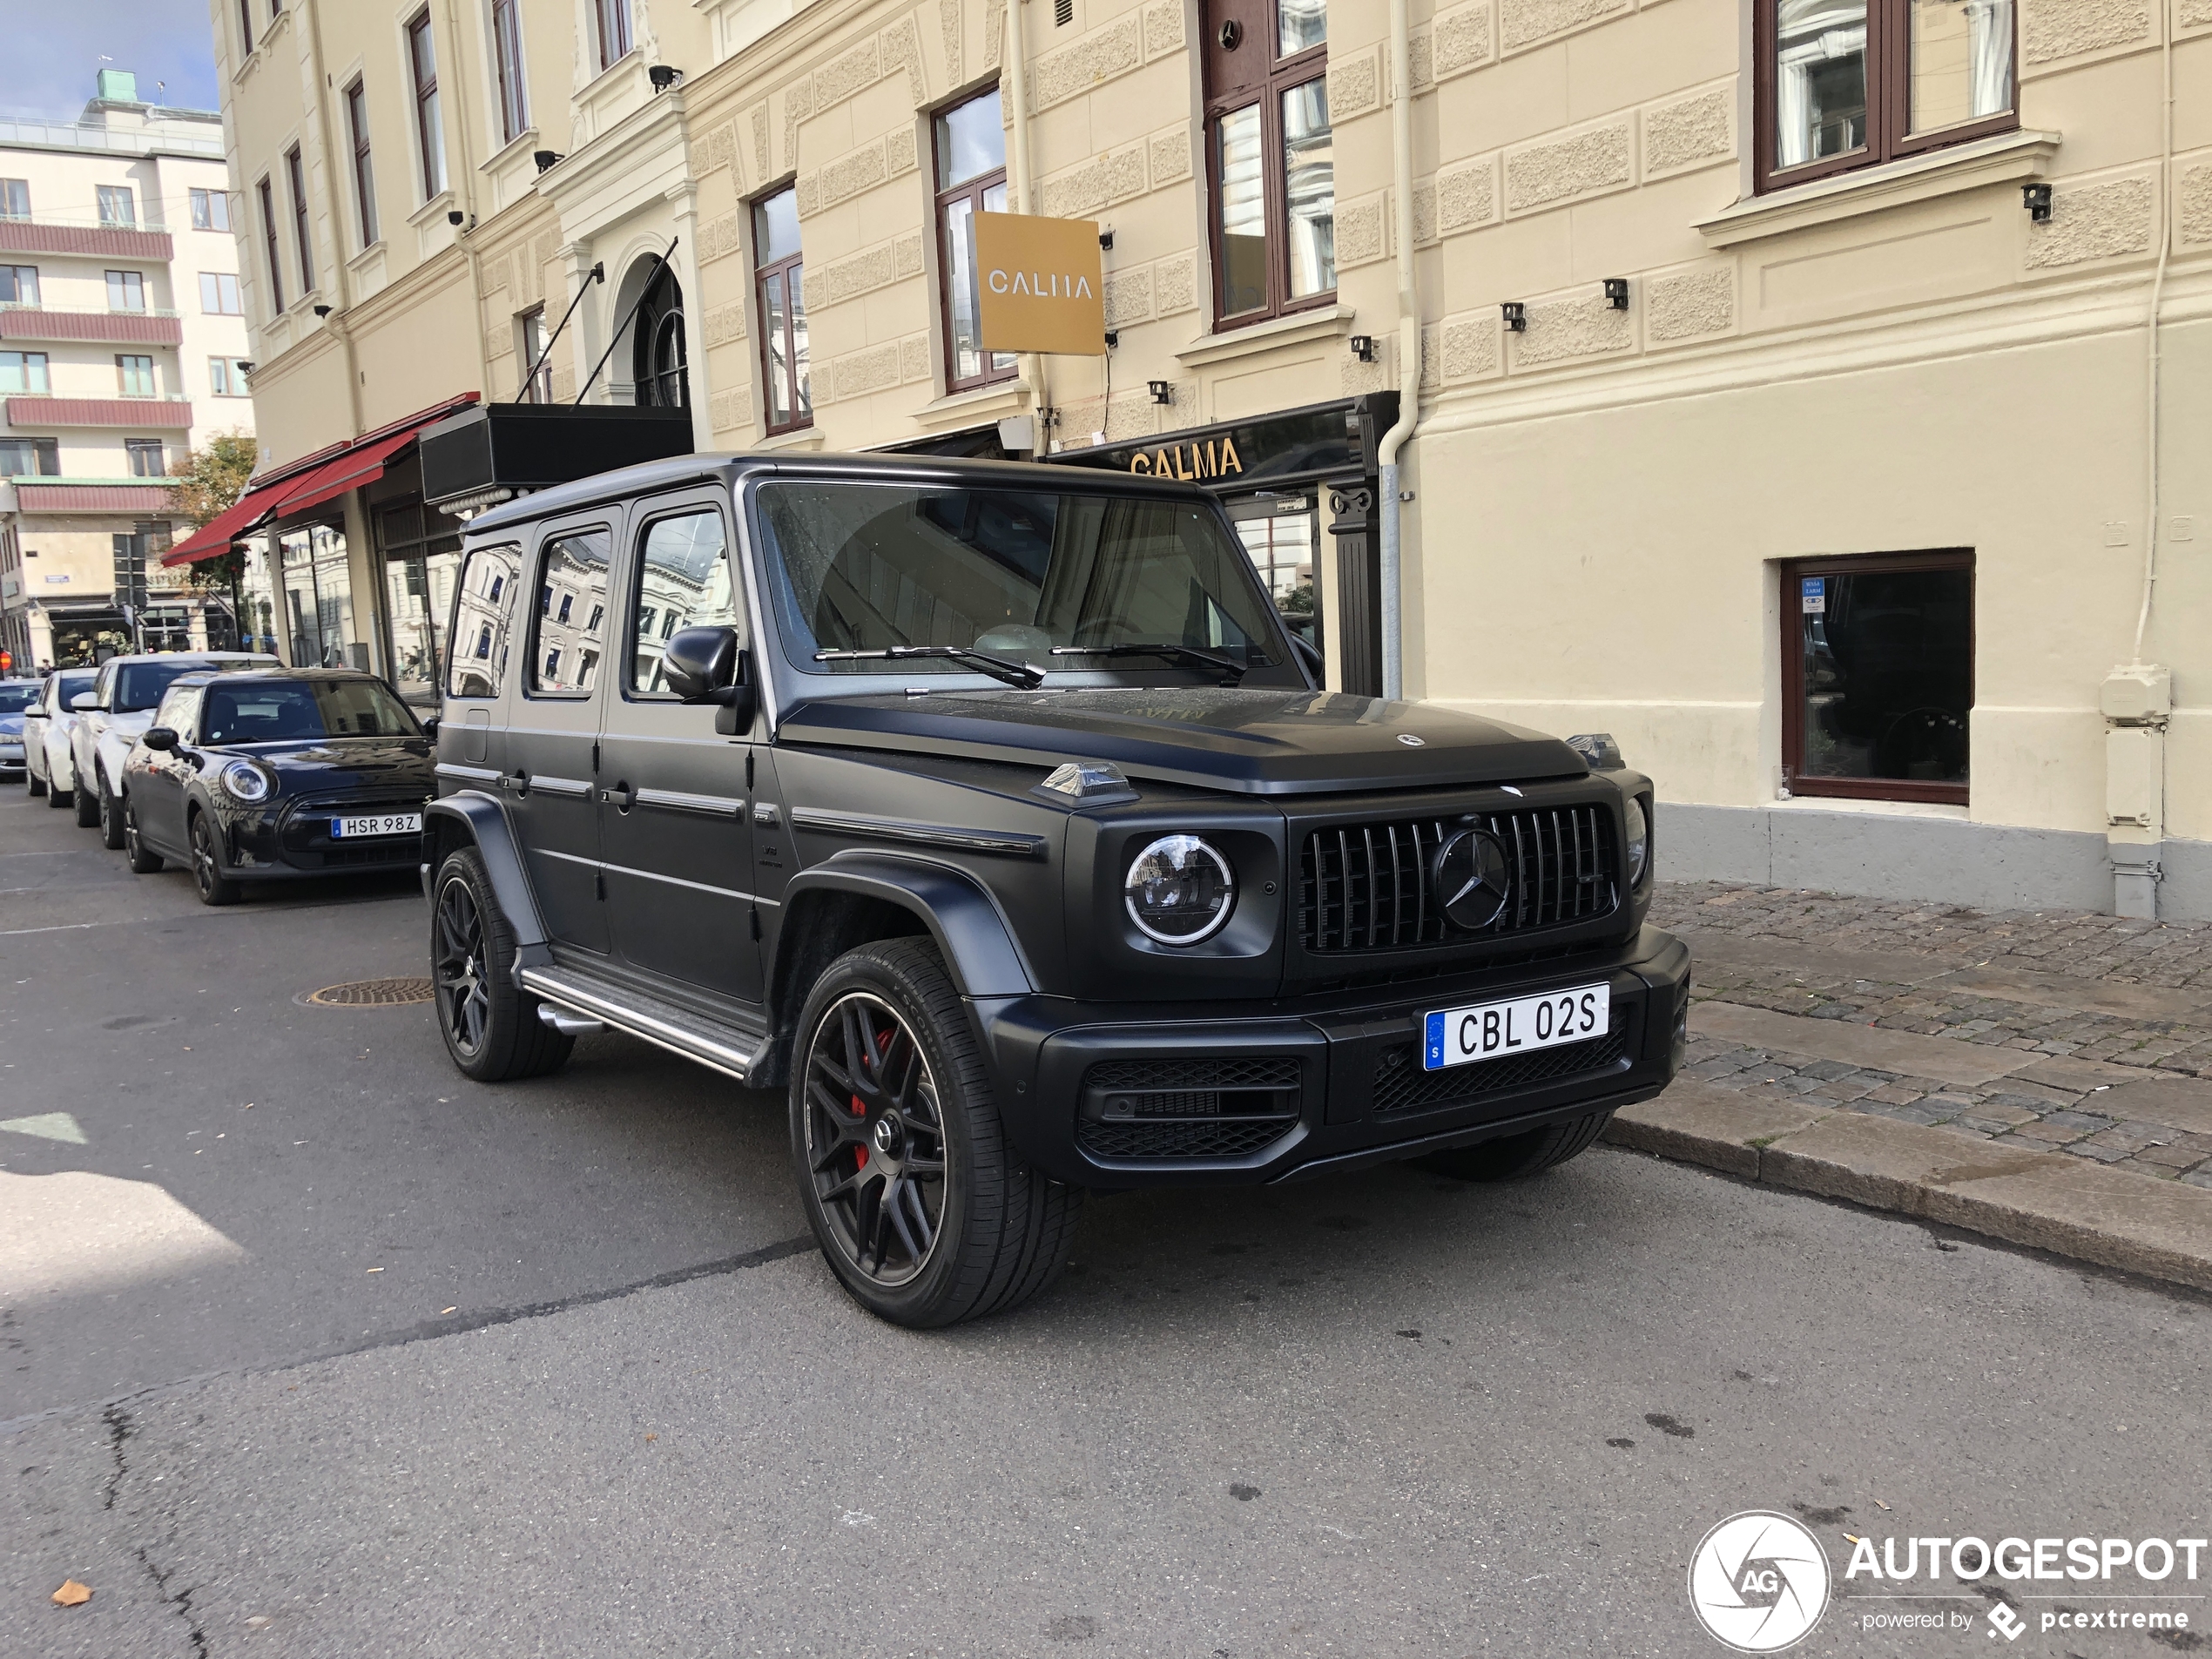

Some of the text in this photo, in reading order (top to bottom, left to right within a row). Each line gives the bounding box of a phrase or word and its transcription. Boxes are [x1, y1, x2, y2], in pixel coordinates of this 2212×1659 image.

[988, 269, 1092, 300] CALMA
[1130, 437, 1243, 481] CALMA
[347, 816, 415, 834] HSR 98Z
[1459, 993, 1595, 1055] CBL 02S
[1432, 1047, 1439, 1058] S
